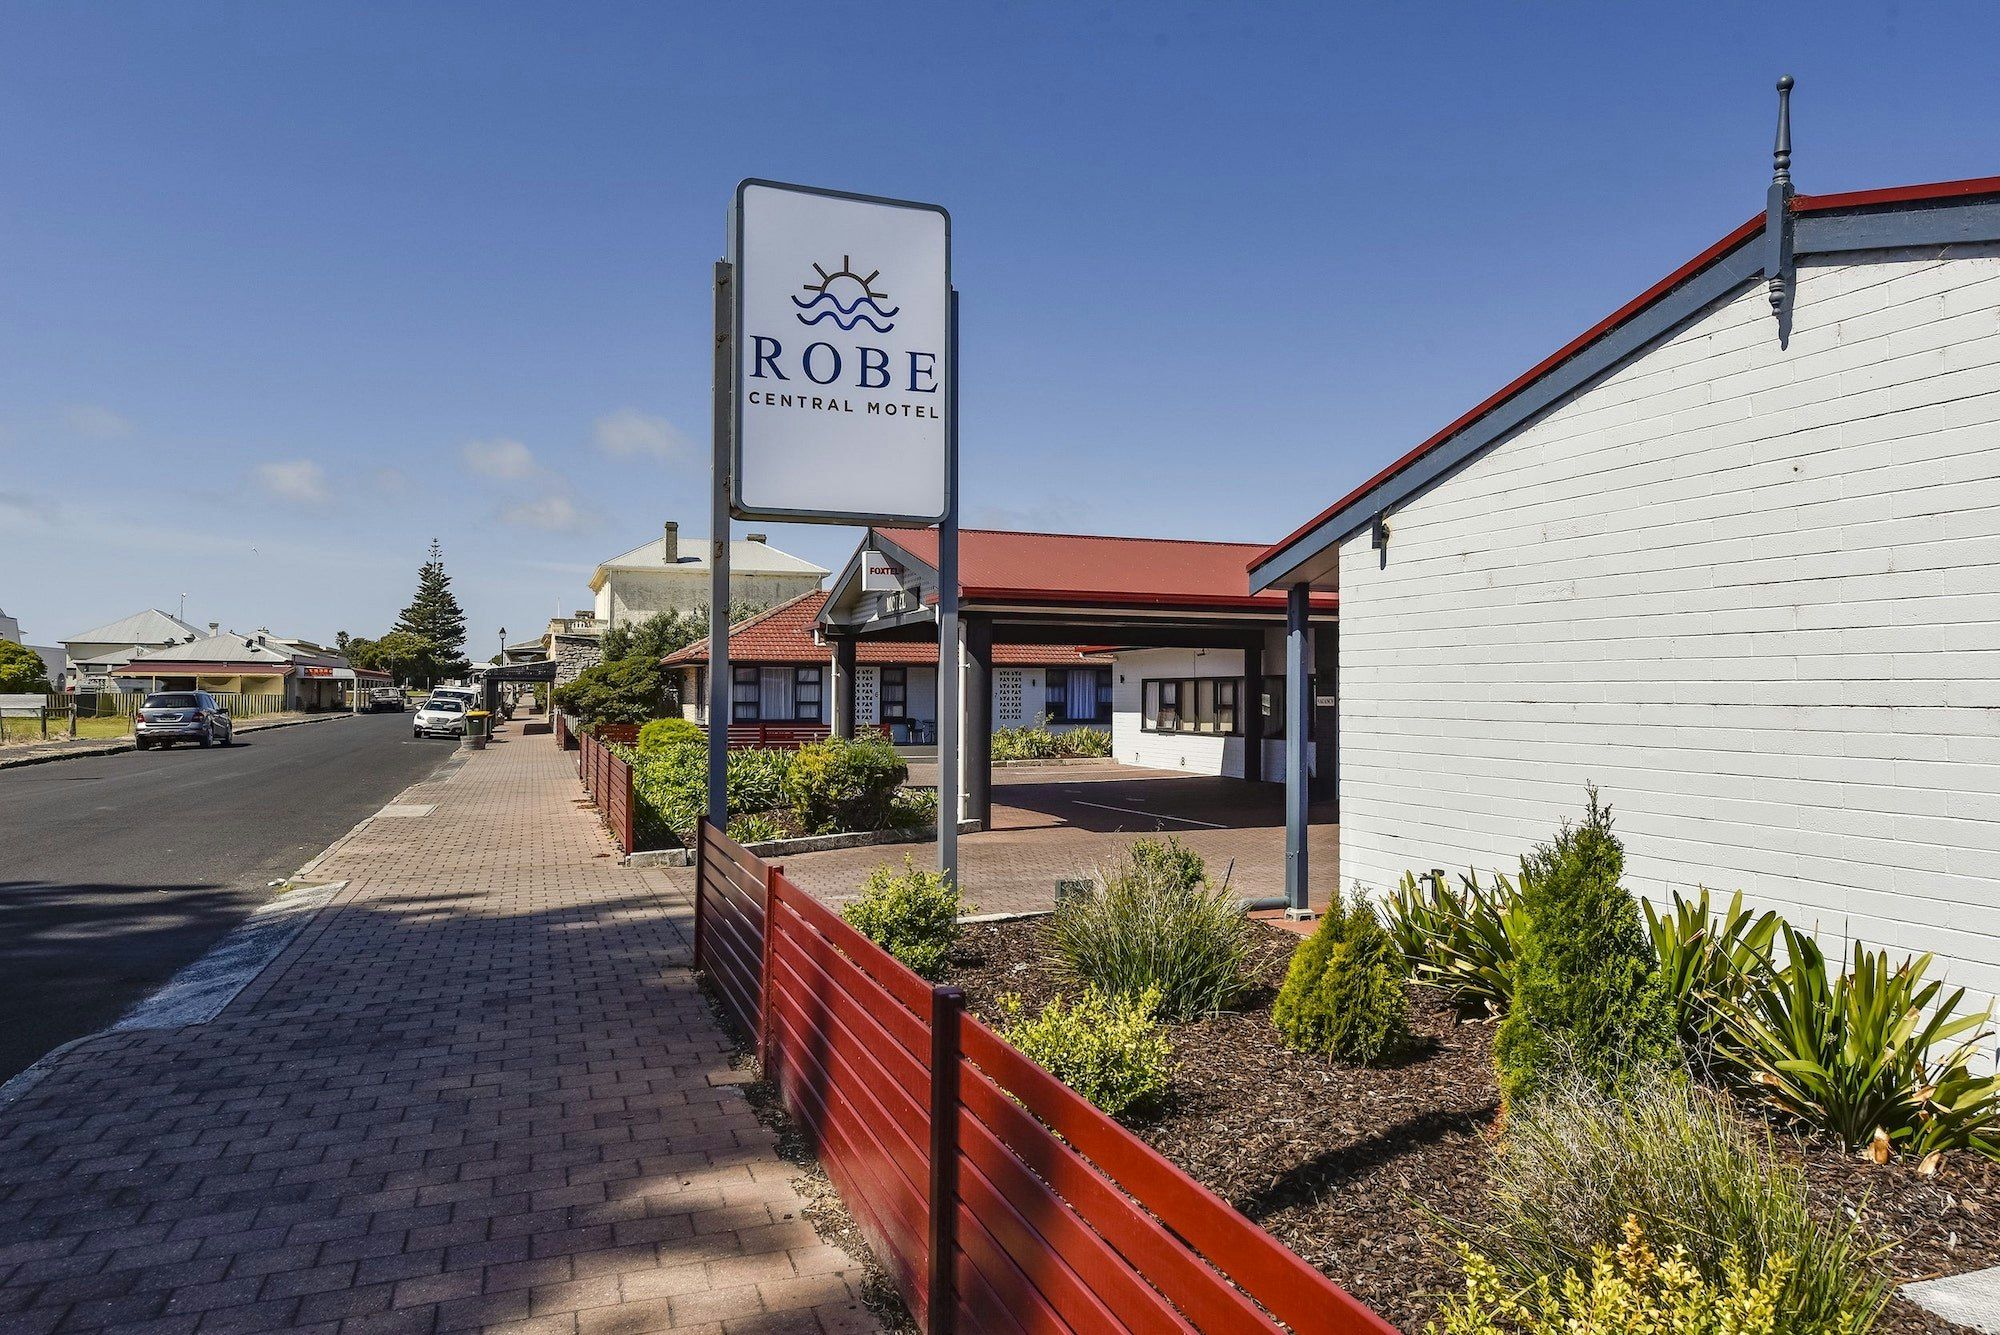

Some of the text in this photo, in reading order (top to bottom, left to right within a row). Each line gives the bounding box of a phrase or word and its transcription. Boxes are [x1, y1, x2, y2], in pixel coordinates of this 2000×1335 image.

[749, 335, 938, 393] ROBE
[749, 391, 939, 419] CENTRAL MOTEL
[869, 567, 900, 575] FOXTEL
